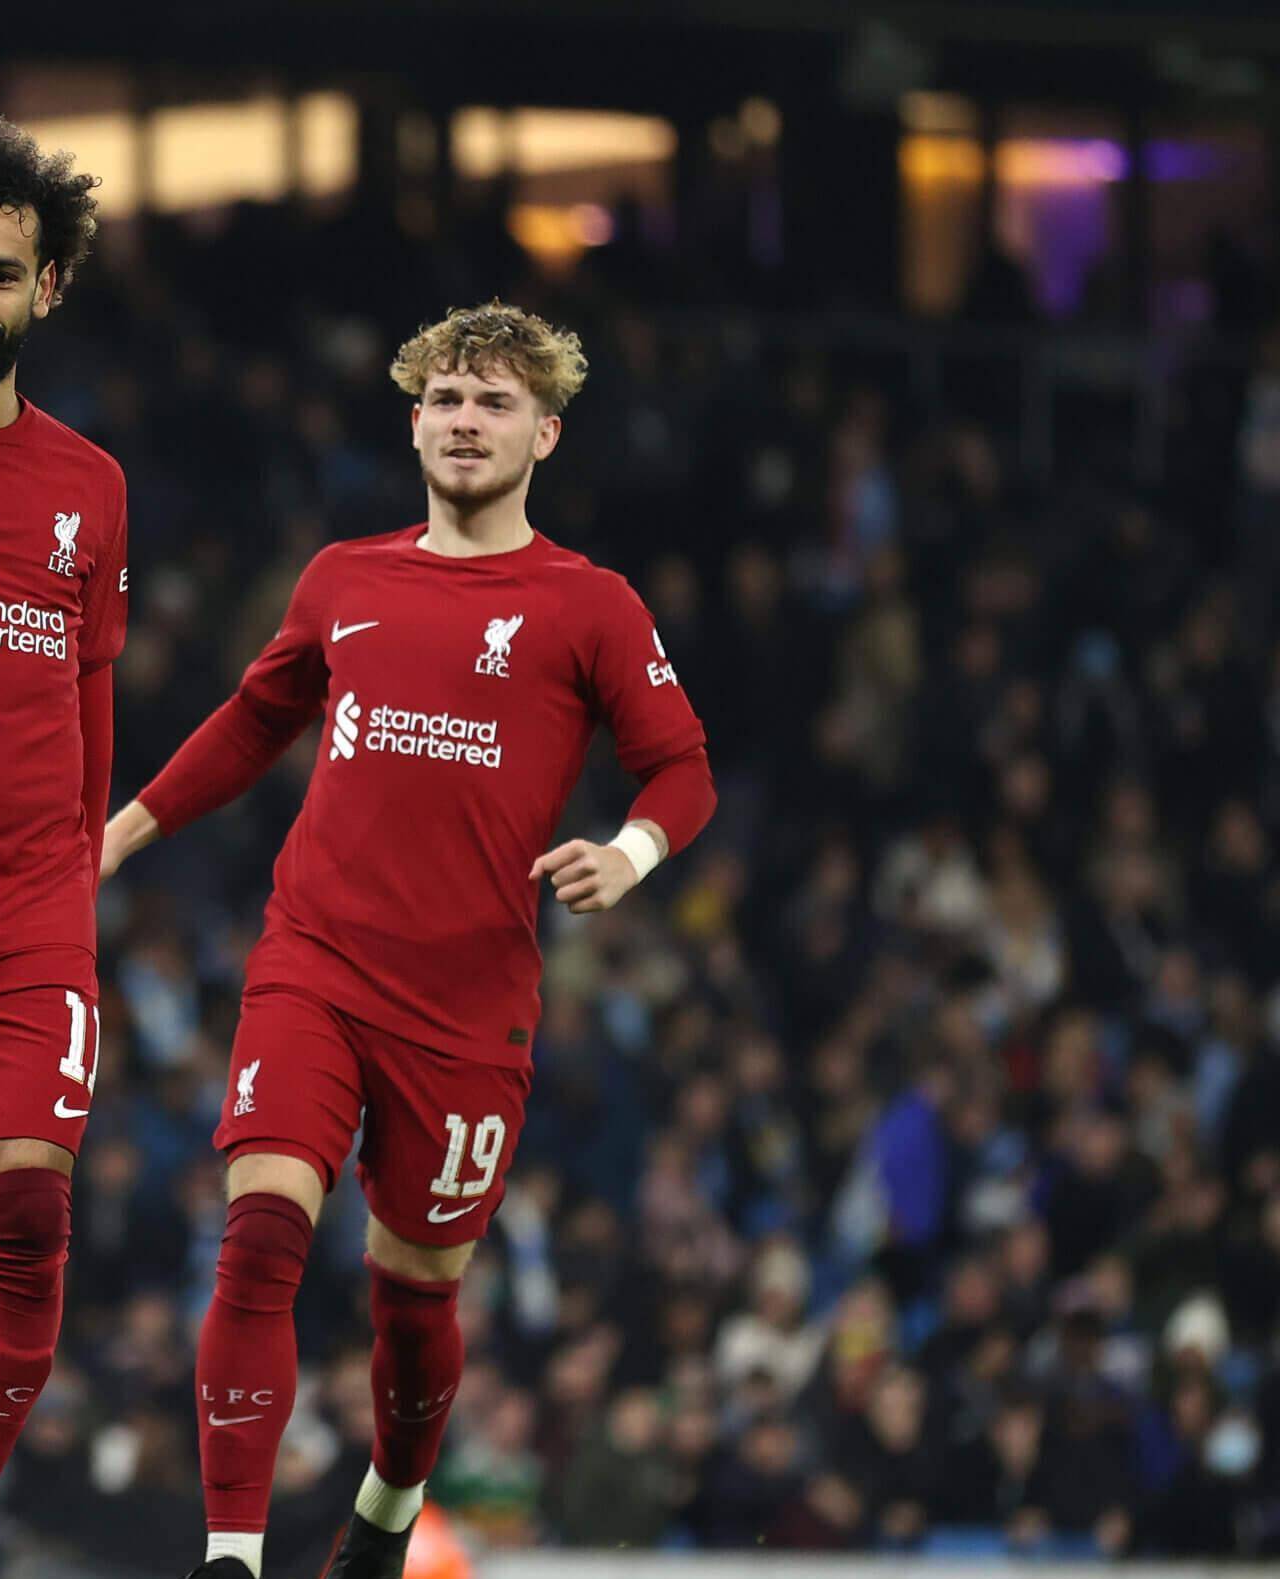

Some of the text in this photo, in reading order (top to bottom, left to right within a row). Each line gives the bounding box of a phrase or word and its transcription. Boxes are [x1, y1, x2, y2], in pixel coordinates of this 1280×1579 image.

[369, 705, 498, 744] standard
[365, 728, 502, 768] chartered
[430, 1113, 506, 1199] 19
